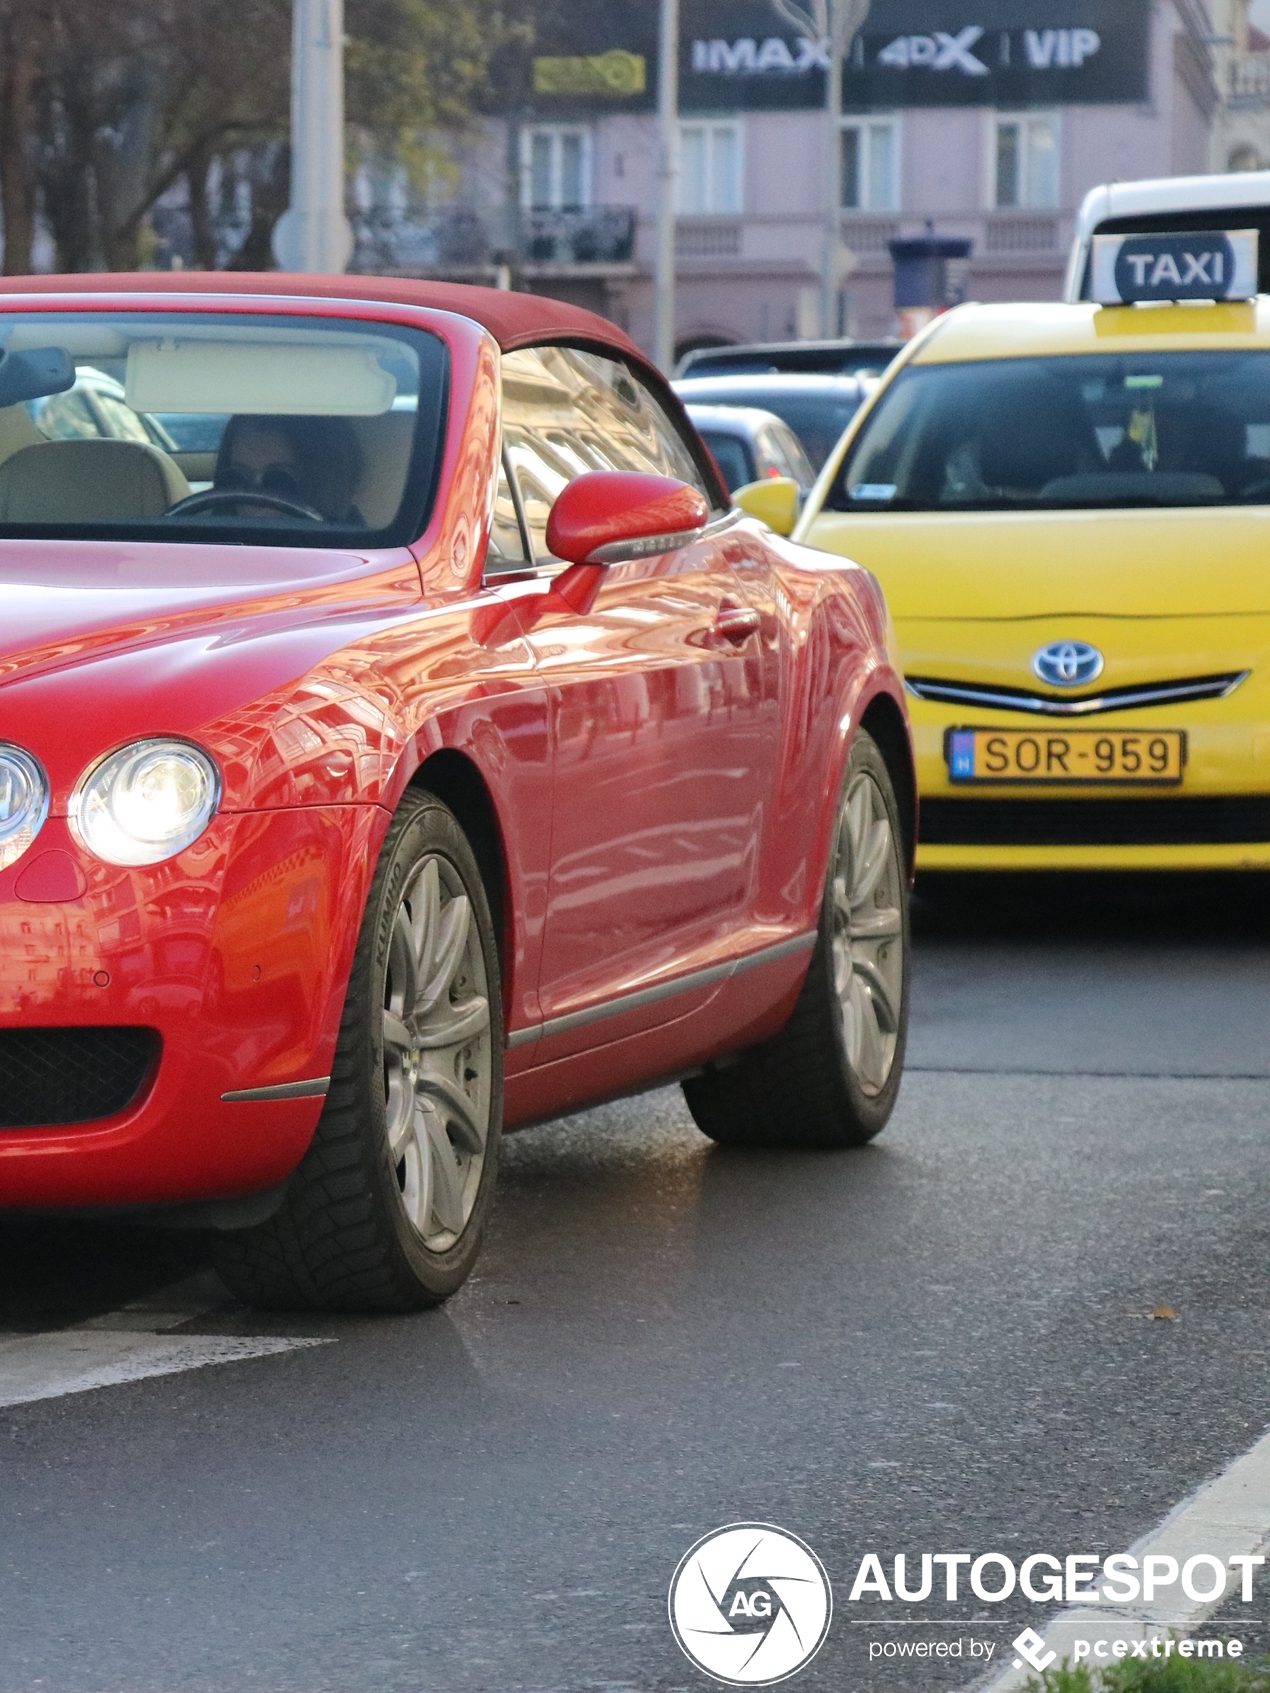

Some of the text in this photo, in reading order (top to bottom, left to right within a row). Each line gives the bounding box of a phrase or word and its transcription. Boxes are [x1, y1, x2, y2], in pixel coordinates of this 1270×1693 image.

[692, 25, 1101, 76] IMAX 4DX VIP
[1127, 252, 1224, 286] TAXI
[958, 758, 970, 771] H
[985, 738, 1169, 773] SOR-959
